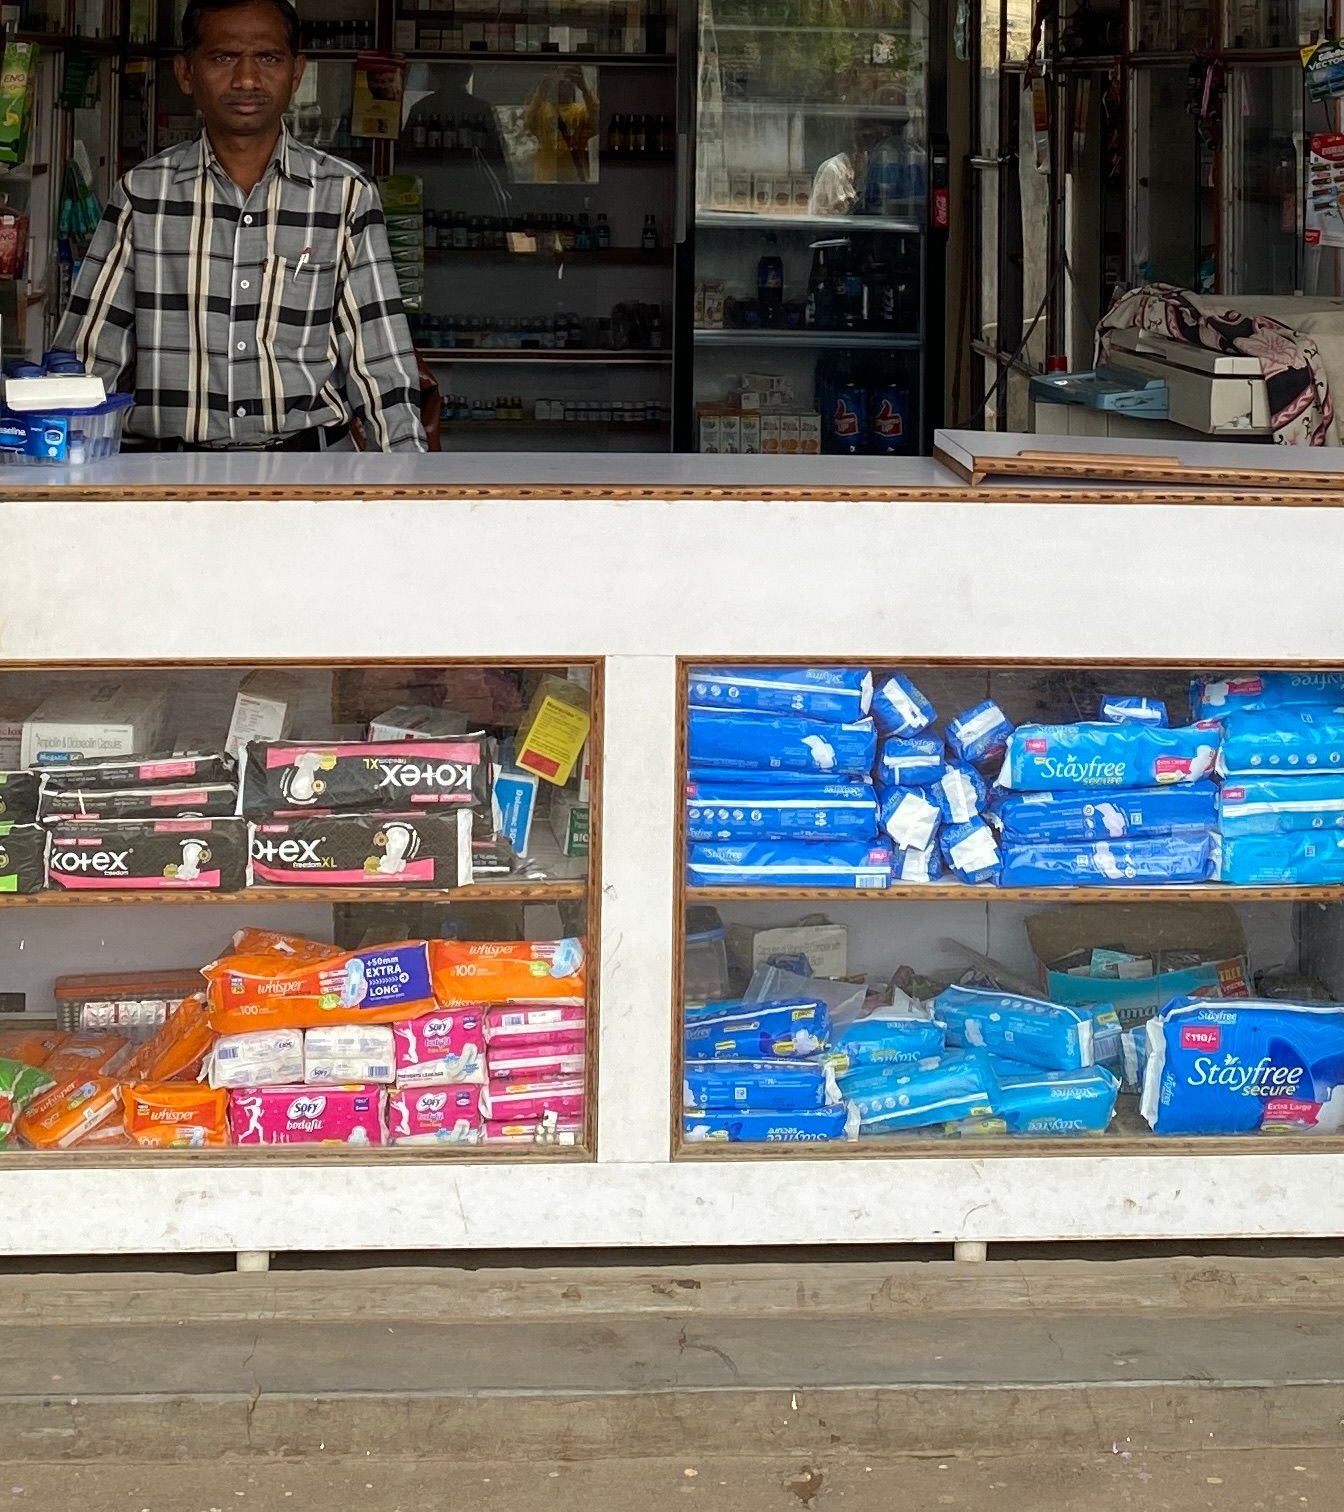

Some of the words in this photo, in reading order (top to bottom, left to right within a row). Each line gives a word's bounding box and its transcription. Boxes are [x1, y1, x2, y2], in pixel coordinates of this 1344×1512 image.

[1041, 755, 1127, 782] Stayfree
[252, 838, 323, 862] otex
[706, 847, 744, 862] Stayfree
[321, 857, 338, 869] XL
[469, 942, 518, 958] whisper
[366, 956, 399, 967] +50mm
[365, 963, 402, 978] EXTRA
[256, 979, 306, 995] whisper
[369, 984, 399, 997] LONG
[1197, 1009, 1238, 1022] Stayfree
[427, 1022, 448, 1032] SOFY
[1187, 1054, 1304, 1092] Stayfree
[1241, 1084, 1298, 1097] secure
[292, 1100, 322, 1117] SOFY
[420, 1098, 441, 1107] SOFY
[1267, 1102, 1288, 1111] Extra
[1289, 1101, 1312, 1112] Large
[150, 1109, 196, 1123] whisper
[285, 1118, 325, 1133] bodyfit
